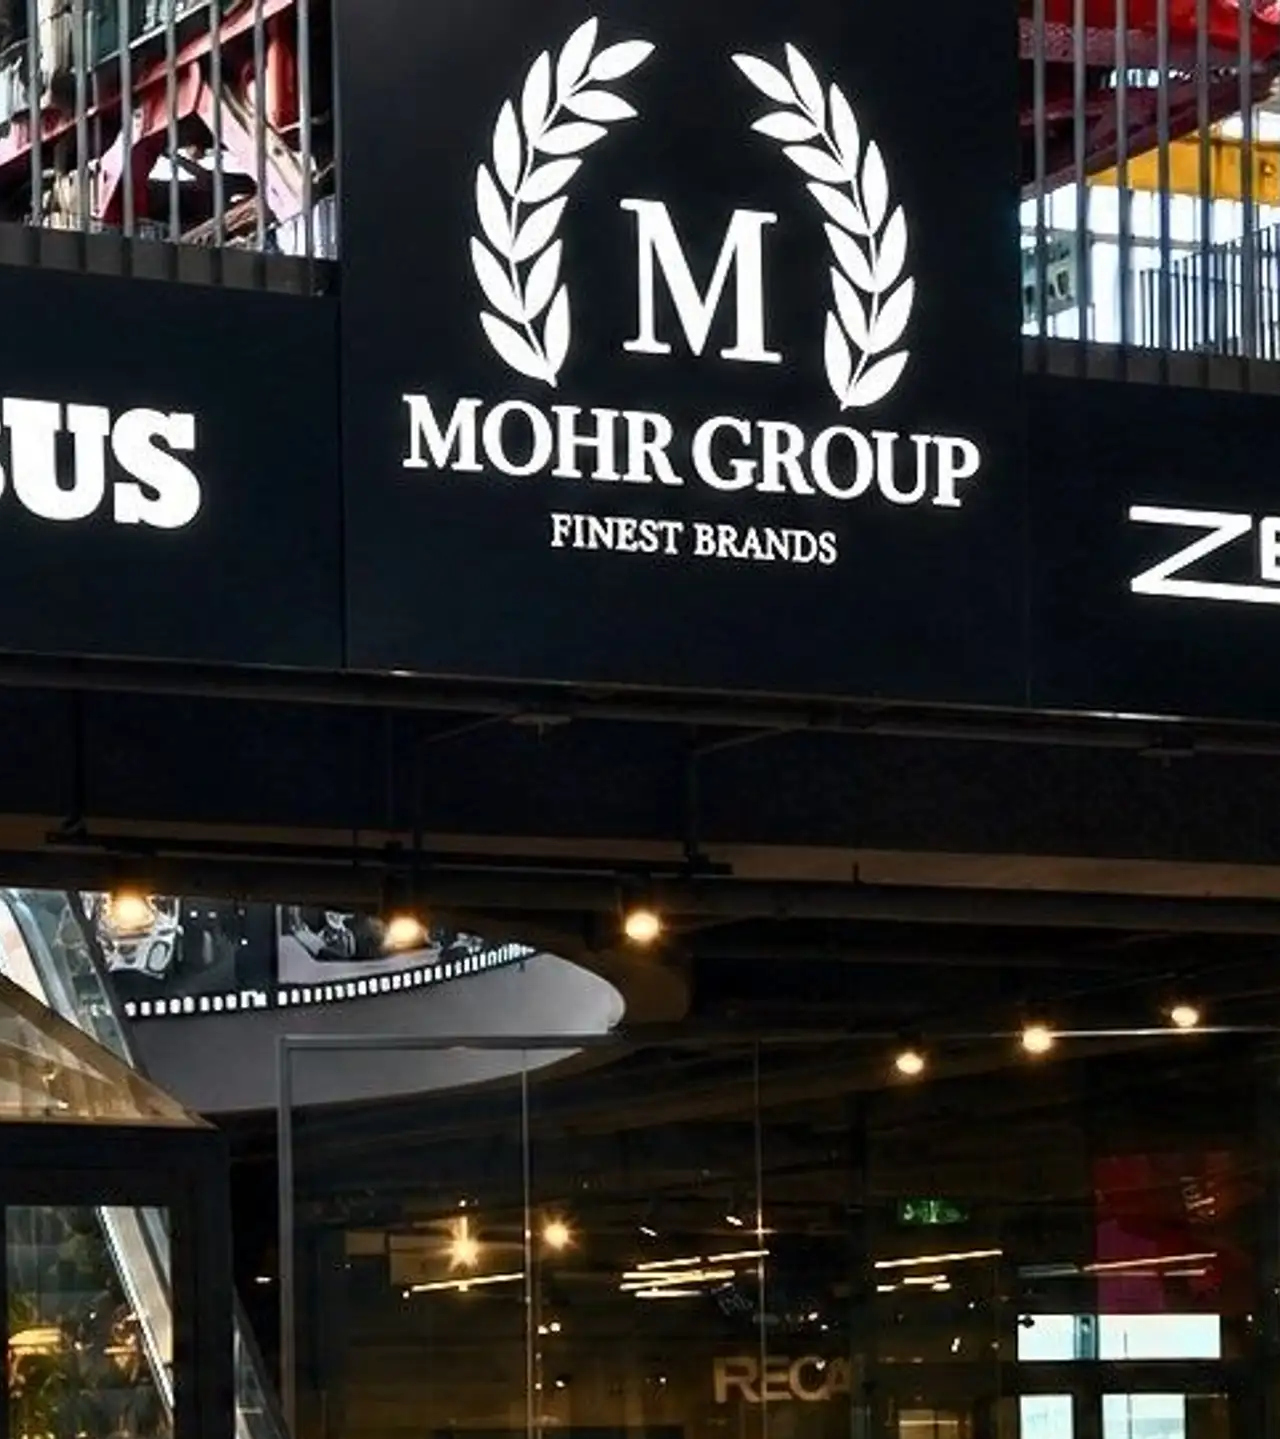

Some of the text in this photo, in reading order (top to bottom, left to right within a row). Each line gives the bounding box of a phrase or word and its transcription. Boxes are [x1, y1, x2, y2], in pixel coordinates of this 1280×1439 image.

[620, 199, 782, 363] M
[403, 393, 980, 507] MOHR GROUP
[551, 514, 837, 565] FINEST BRANDS
